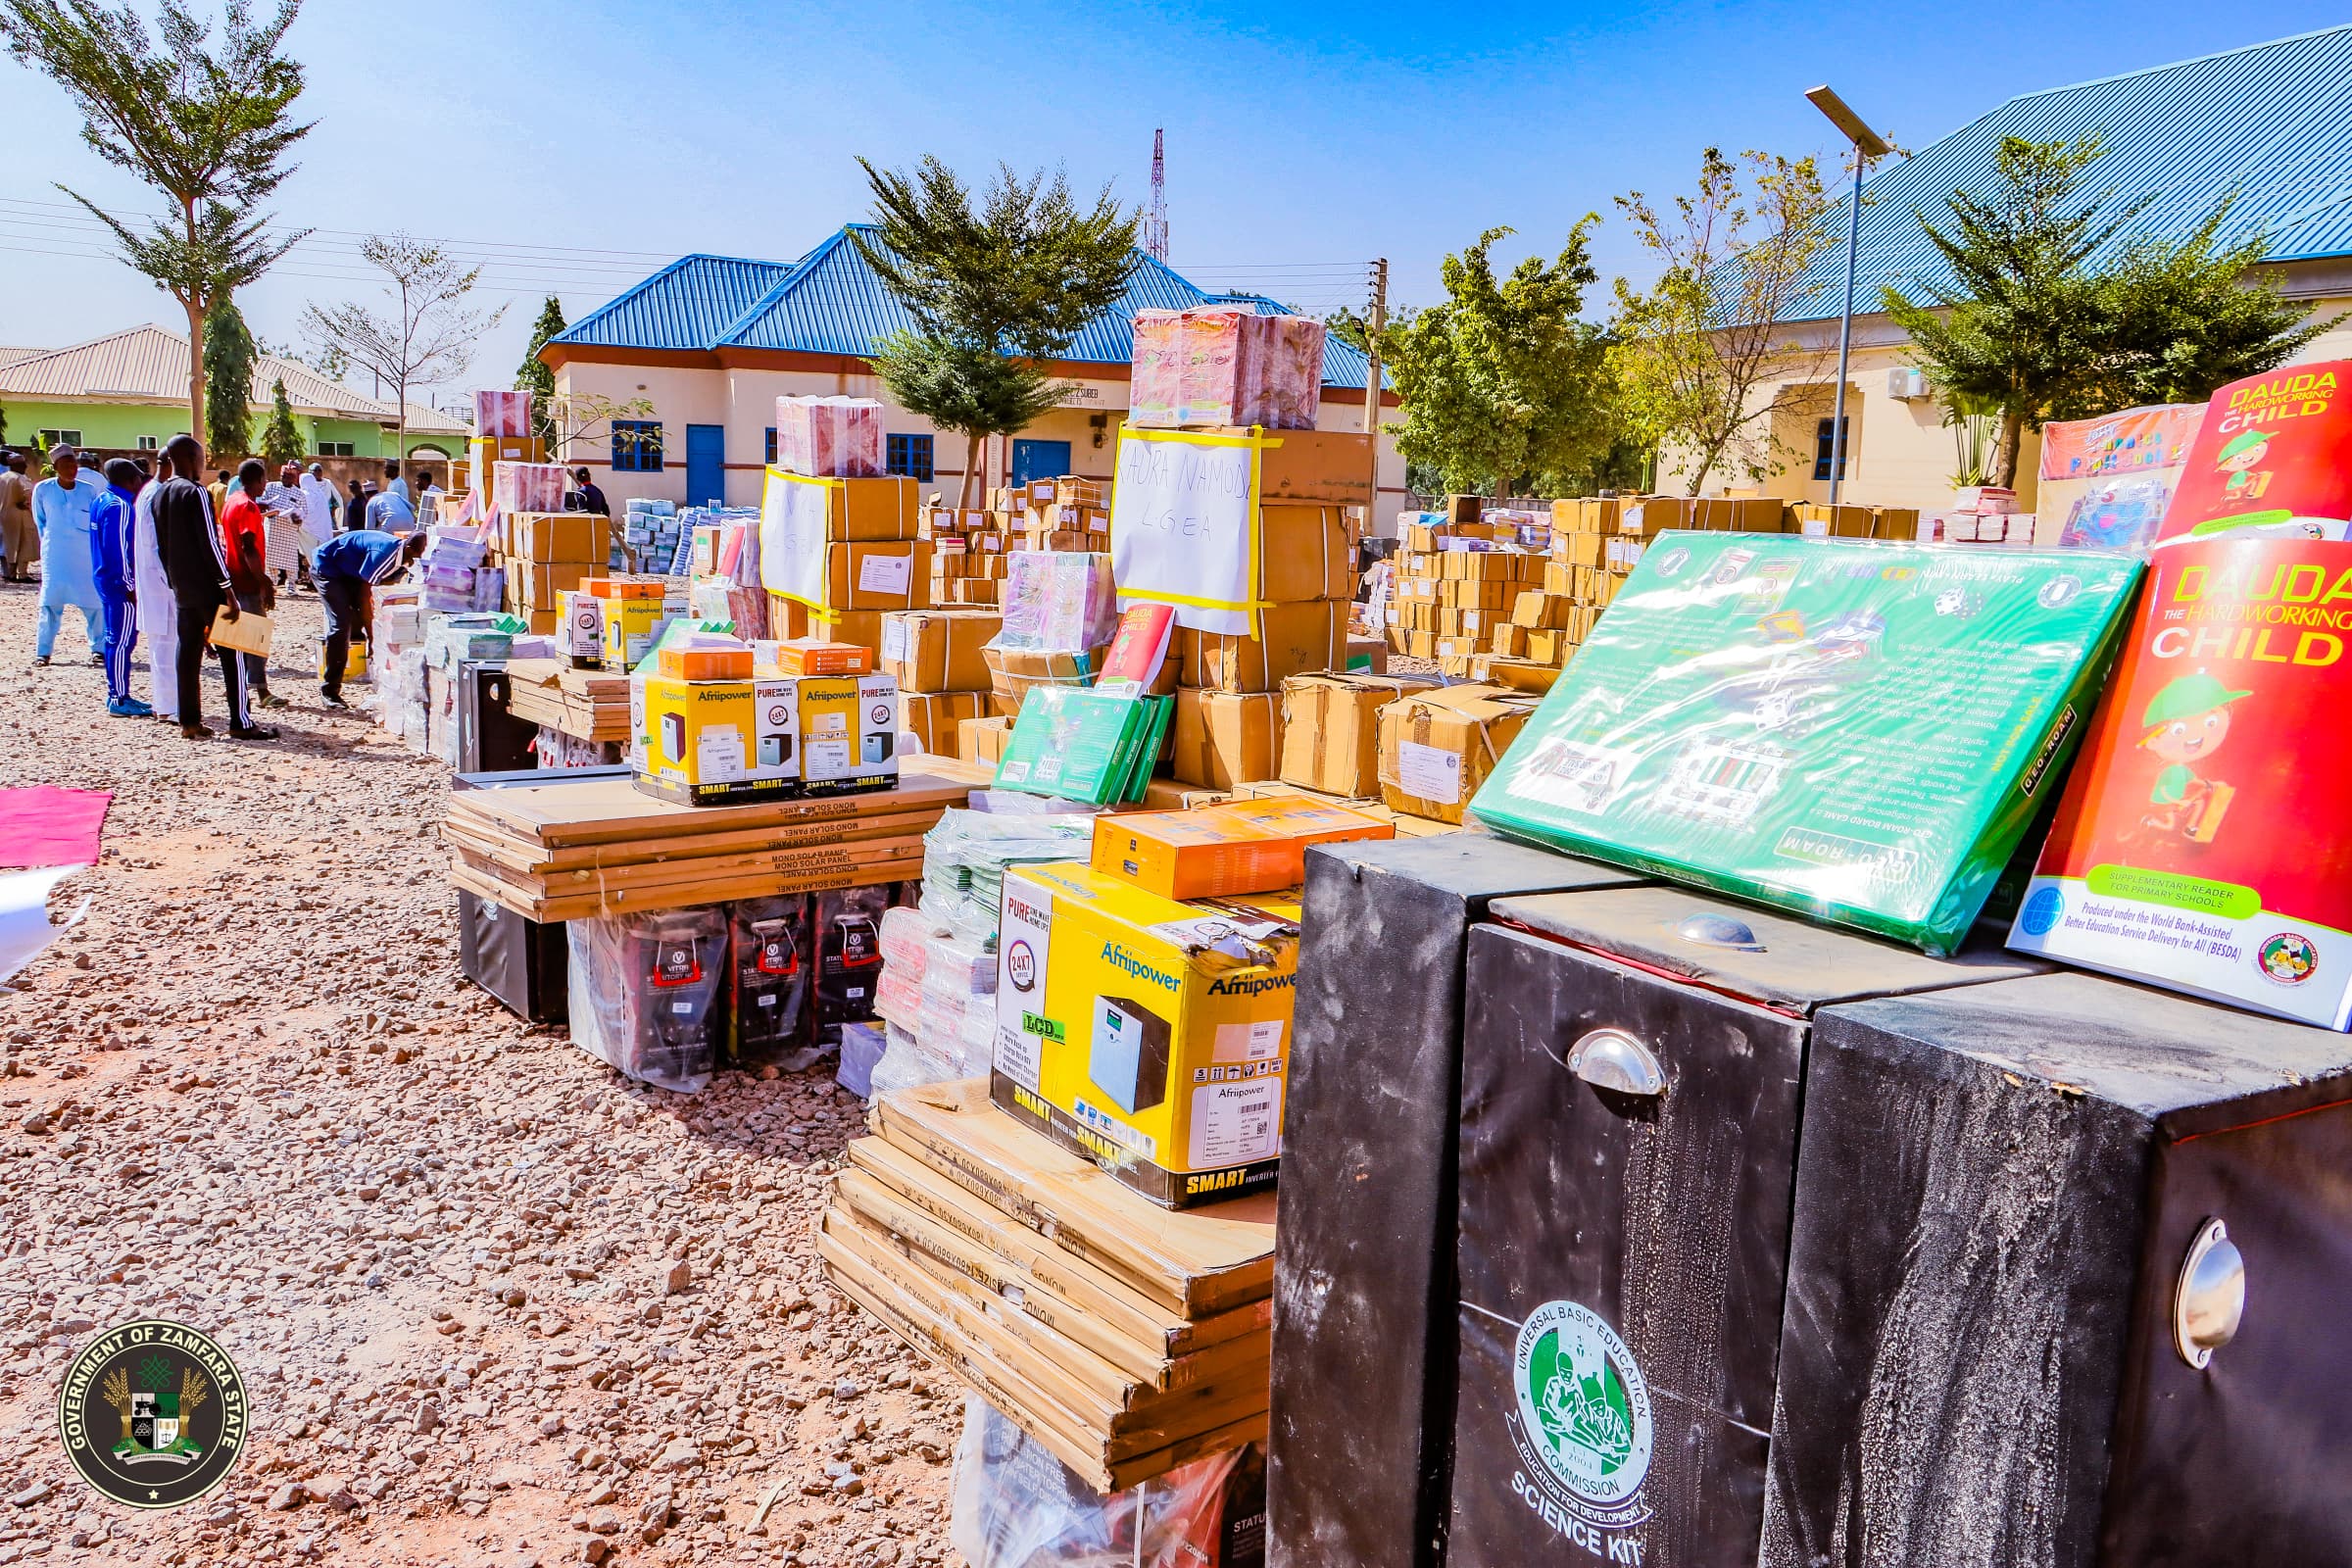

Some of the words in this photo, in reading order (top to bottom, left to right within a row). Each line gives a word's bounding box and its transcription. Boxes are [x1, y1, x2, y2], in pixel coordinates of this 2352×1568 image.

[2230, 371, 2336, 409] DAUDA
[2237, 389, 2333, 415] HARDWORKING
[2219, 400, 2328, 433] CHILD
[2164, 609, 2187, 620] THE
[2184, 605, 2352, 630] HARDWORKING
[2151, 626, 2344, 666] CHILD
[698, 691, 752, 702] Afriipower
[758, 689, 776, 699] PURE
[806, 690, 857, 702] Afriipower
[861, 688, 879, 698] PURE
[2026, 710, 2072, 789] GEO-ROAM
[699, 784, 730, 794] SMART
[753, 779, 782, 793] SMART
[857, 776, 884, 786] SMART
[1821, 809, 1849, 821] GAME
[1848, 814, 1882, 829] BOARD
[772, 854, 796, 862] MONO
[797, 851, 821, 859] SOLAR
[775, 861, 798, 870] MONO
[800, 858, 825, 867] SOLAR
[828, 855, 852, 863] PANEL
[777, 884, 801, 893] PANEL
[2109, 871, 2189, 894] SUPPLEMENTARY
[2191, 885, 2233, 900] READER
[2111, 883, 2129, 893] FOR
[2131, 886, 2173, 901] PRIMARY
[2176, 892, 2225, 908] SCHOOLS
[1008, 897, 1030, 924] PURE
[2082, 902, 2113, 918] Produced
[2115, 906, 2135, 921] under
[2136, 910, 2149, 923] the
[2151, 912, 2173, 929] World
[2175, 918, 2232, 940] Bank-Assisted
[2065, 915, 2084, 928] Better
[2086, 920, 2119, 935] Education
[2121, 925, 2146, 940] Service
[2147, 930, 2179, 948] Delivery
[2180, 935, 2192, 949] for
[2193, 938, 2205, 953] All
[2207, 941, 2242, 963] (BESDA)
[1011, 954, 1031, 972] 24X7
[1101, 940, 1181, 993] Afriipower
[1207, 972, 1297, 997] Afriipowe
[1026, 1015, 1054, 1038] LCD
[1218, 1087, 1264, 1099] Afriipower
[1014, 1085, 1051, 1121] SMART
[1077, 1126, 1121, 1166] SMART
[1187, 1168, 1248, 1195] SMART
[1518, 1308, 1556, 1370] UNIVERSAL
[1558, 1306, 1593, 1329] BASIC
[1596, 1326, 1647, 1418] EDUCATION
[1046, 1463, 1067, 1486] FREE
[1543, 1445, 1620, 1494] COMMISSION
[1043, 1476, 1076, 1507] TOPPING
[1519, 1443, 1560, 1495] EDUCATION
[1560, 1493, 1579, 1512] FOR
[1580, 1504, 1641, 1523] DEVELOPMENT
[1234, 1512, 1267, 1533] STATU
[1510, 1470, 1602, 1557] SCIENCE
[1607, 1535, 1642, 1567] KIT
